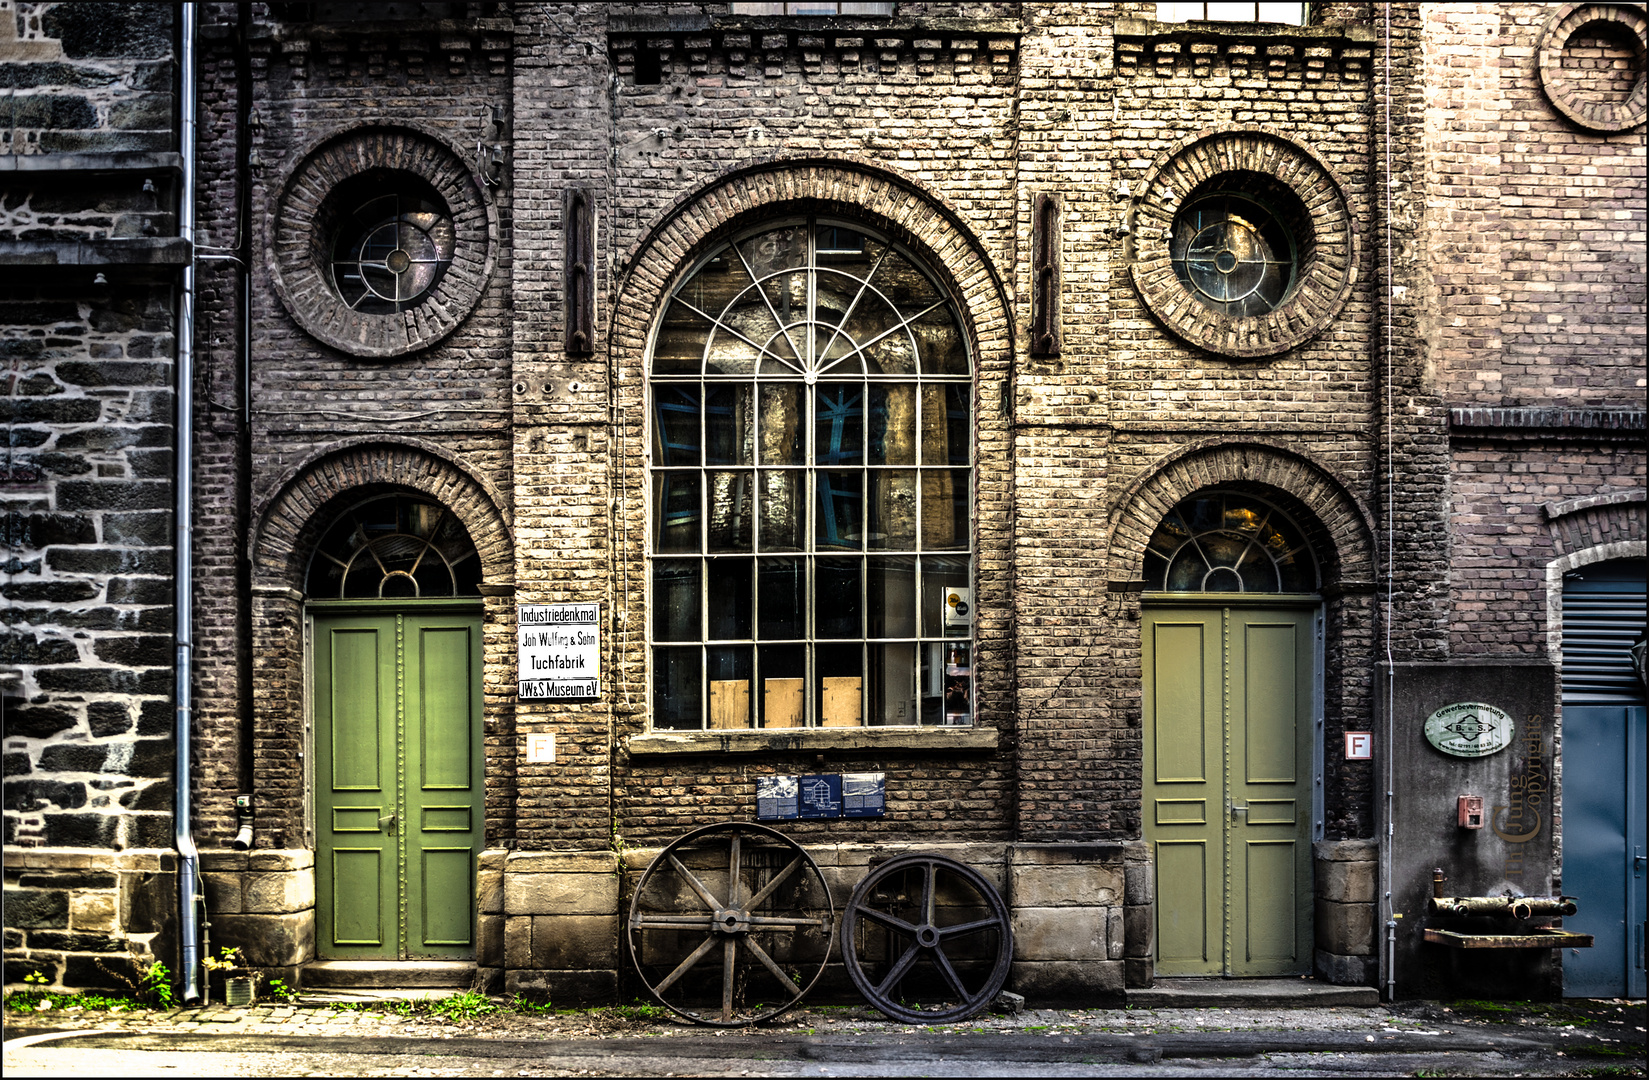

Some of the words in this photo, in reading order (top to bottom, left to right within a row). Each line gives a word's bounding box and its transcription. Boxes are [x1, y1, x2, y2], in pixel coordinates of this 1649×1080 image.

[521, 606, 597, 622] Industriedenkmal
[523, 632, 537, 647] Joh
[570, 636, 576, 646] &
[577, 631, 596, 646] Sohn
[531, 654, 585, 670] Tuchfabrik
[520, 682, 545, 697] JW&S
[547, 681, 585, 697] Museum
[1435, 703, 1505, 720] Gewerbevermietung
[1455, 724, 1465, 732] B.
[1477, 724, 1486, 732] S.
[535, 739, 547, 758] F
[1352, 736, 1366, 755] F
